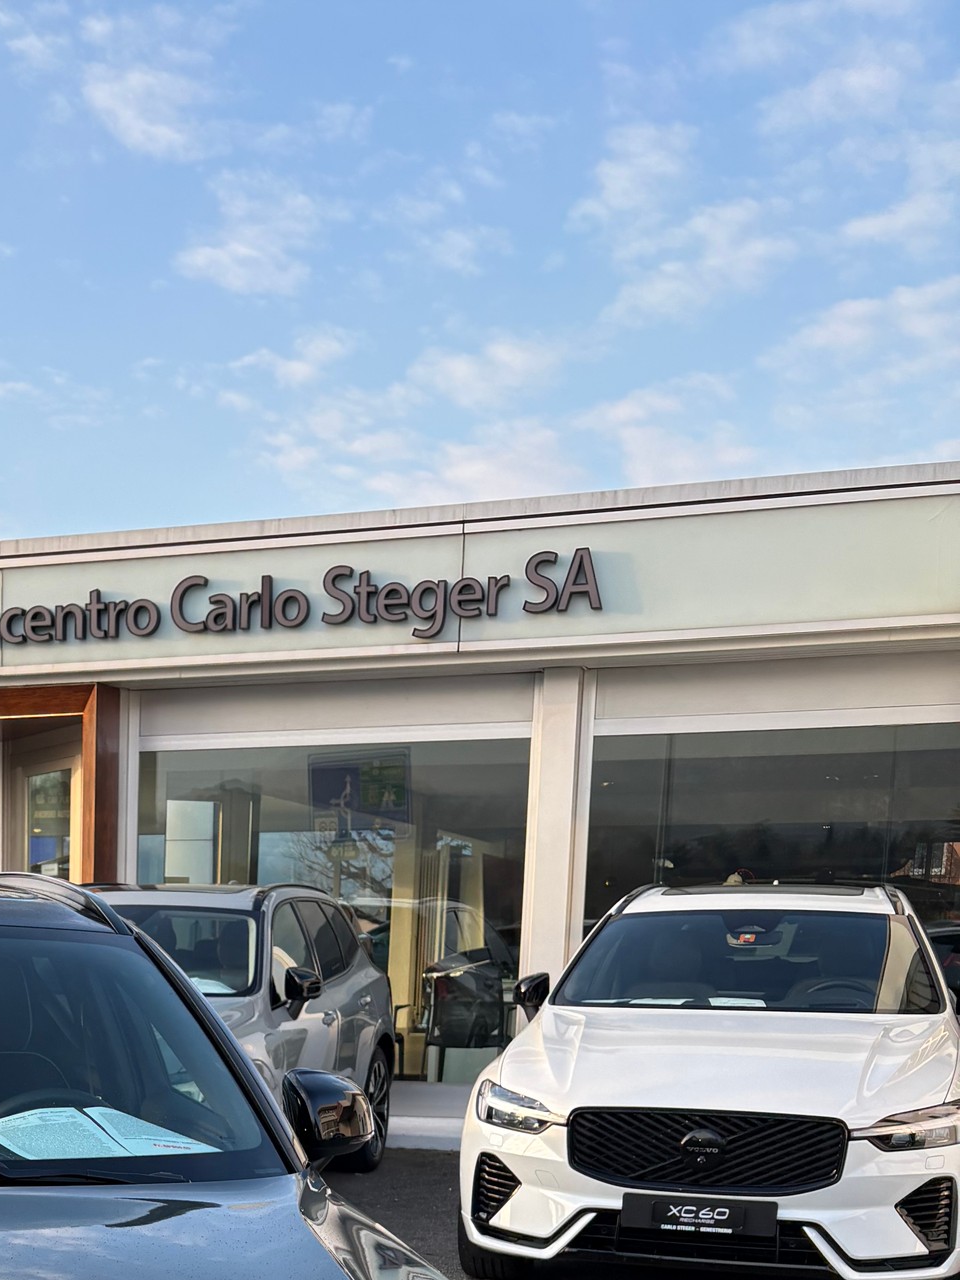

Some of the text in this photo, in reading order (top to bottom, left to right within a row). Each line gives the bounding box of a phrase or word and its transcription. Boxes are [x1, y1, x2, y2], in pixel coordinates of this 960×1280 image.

[170, 575, 309, 633] Carlo
[322, 564, 510, 639] Steger
[523, 547, 602, 614] SA
